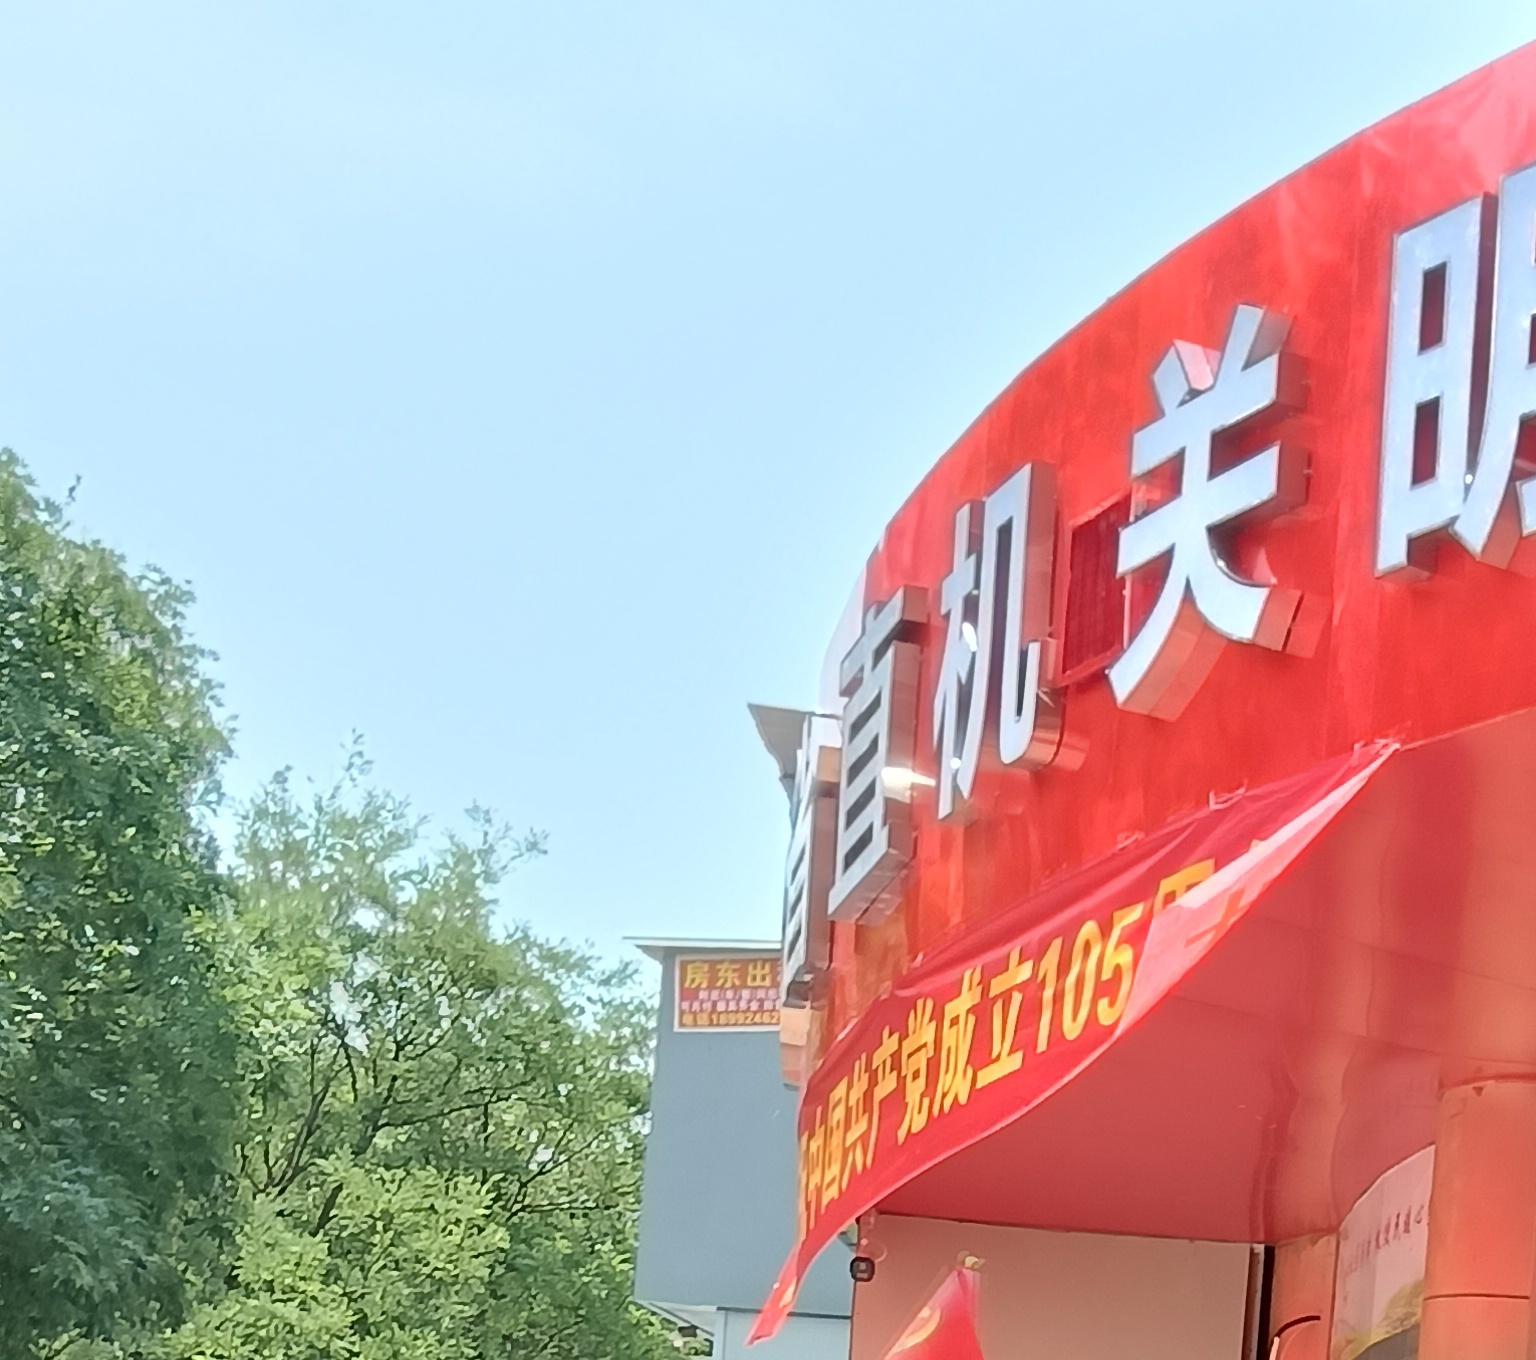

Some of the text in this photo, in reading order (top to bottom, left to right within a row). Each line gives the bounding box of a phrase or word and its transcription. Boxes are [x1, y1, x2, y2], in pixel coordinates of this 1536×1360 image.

[684, 960, 781, 988] 房东出
[799, 858, 1216, 1248] 中国共产党成立105
